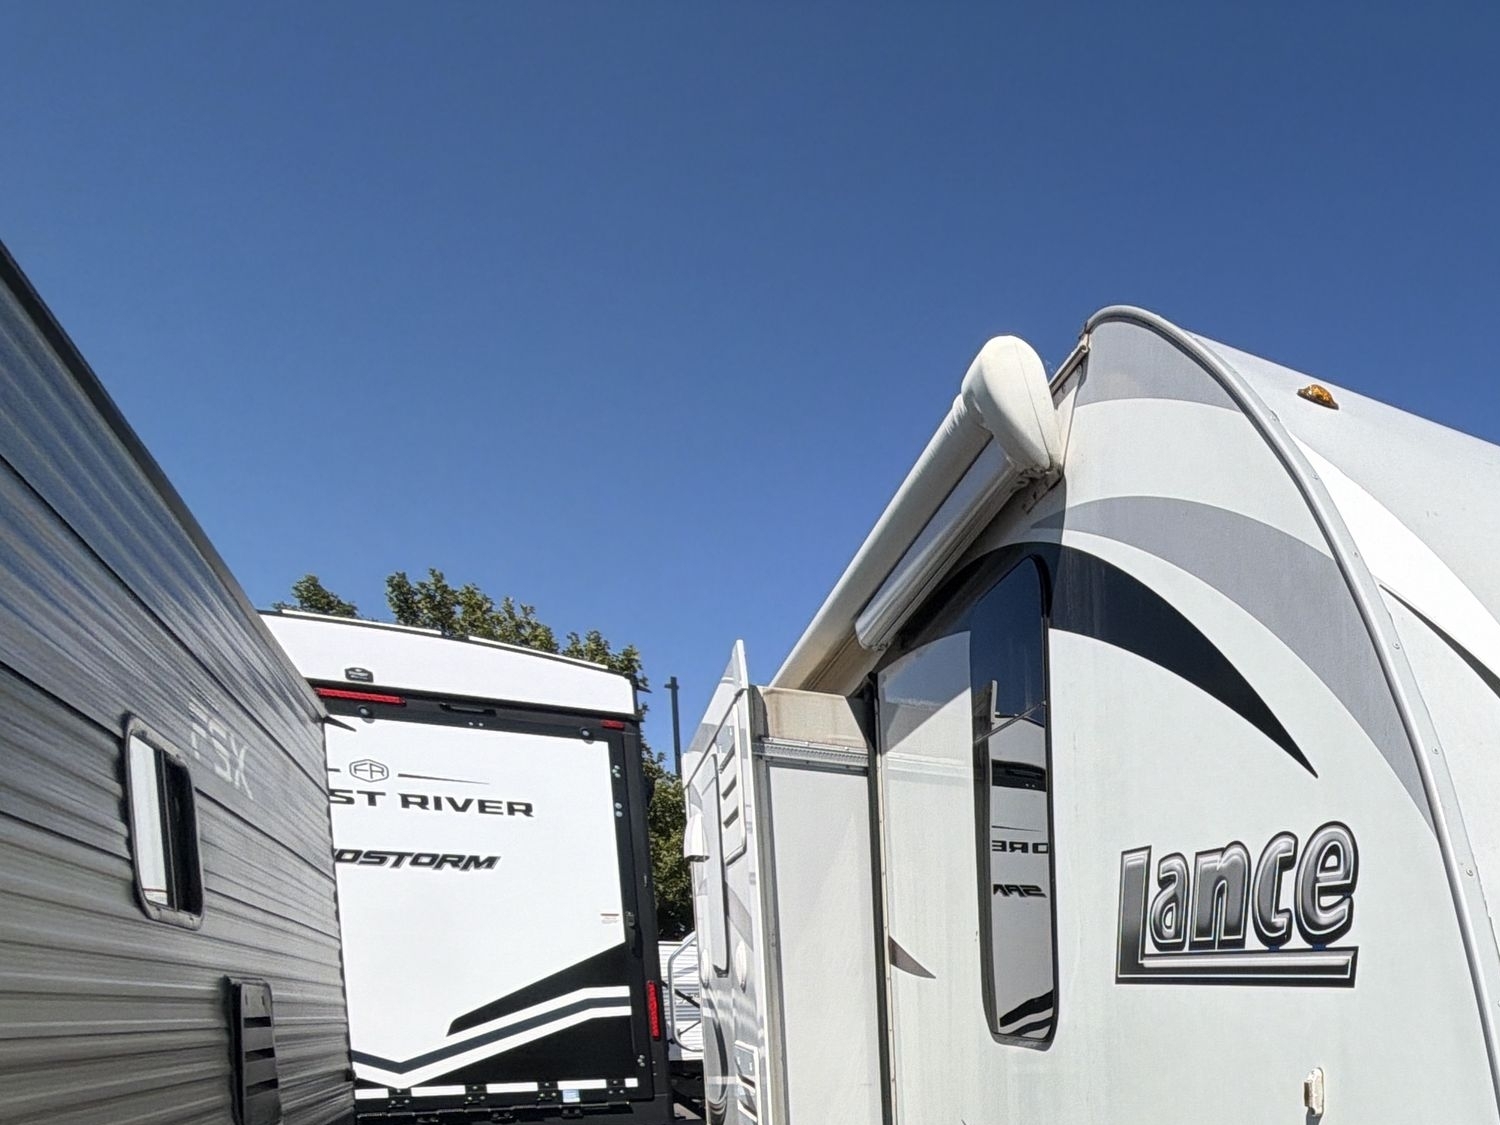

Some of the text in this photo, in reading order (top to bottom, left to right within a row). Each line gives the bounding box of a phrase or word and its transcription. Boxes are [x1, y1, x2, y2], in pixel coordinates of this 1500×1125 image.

[398, 793, 535, 817] RIVER
[333, 849, 501, 871] DSTORM
[1115, 820, 1359, 988] Lance
